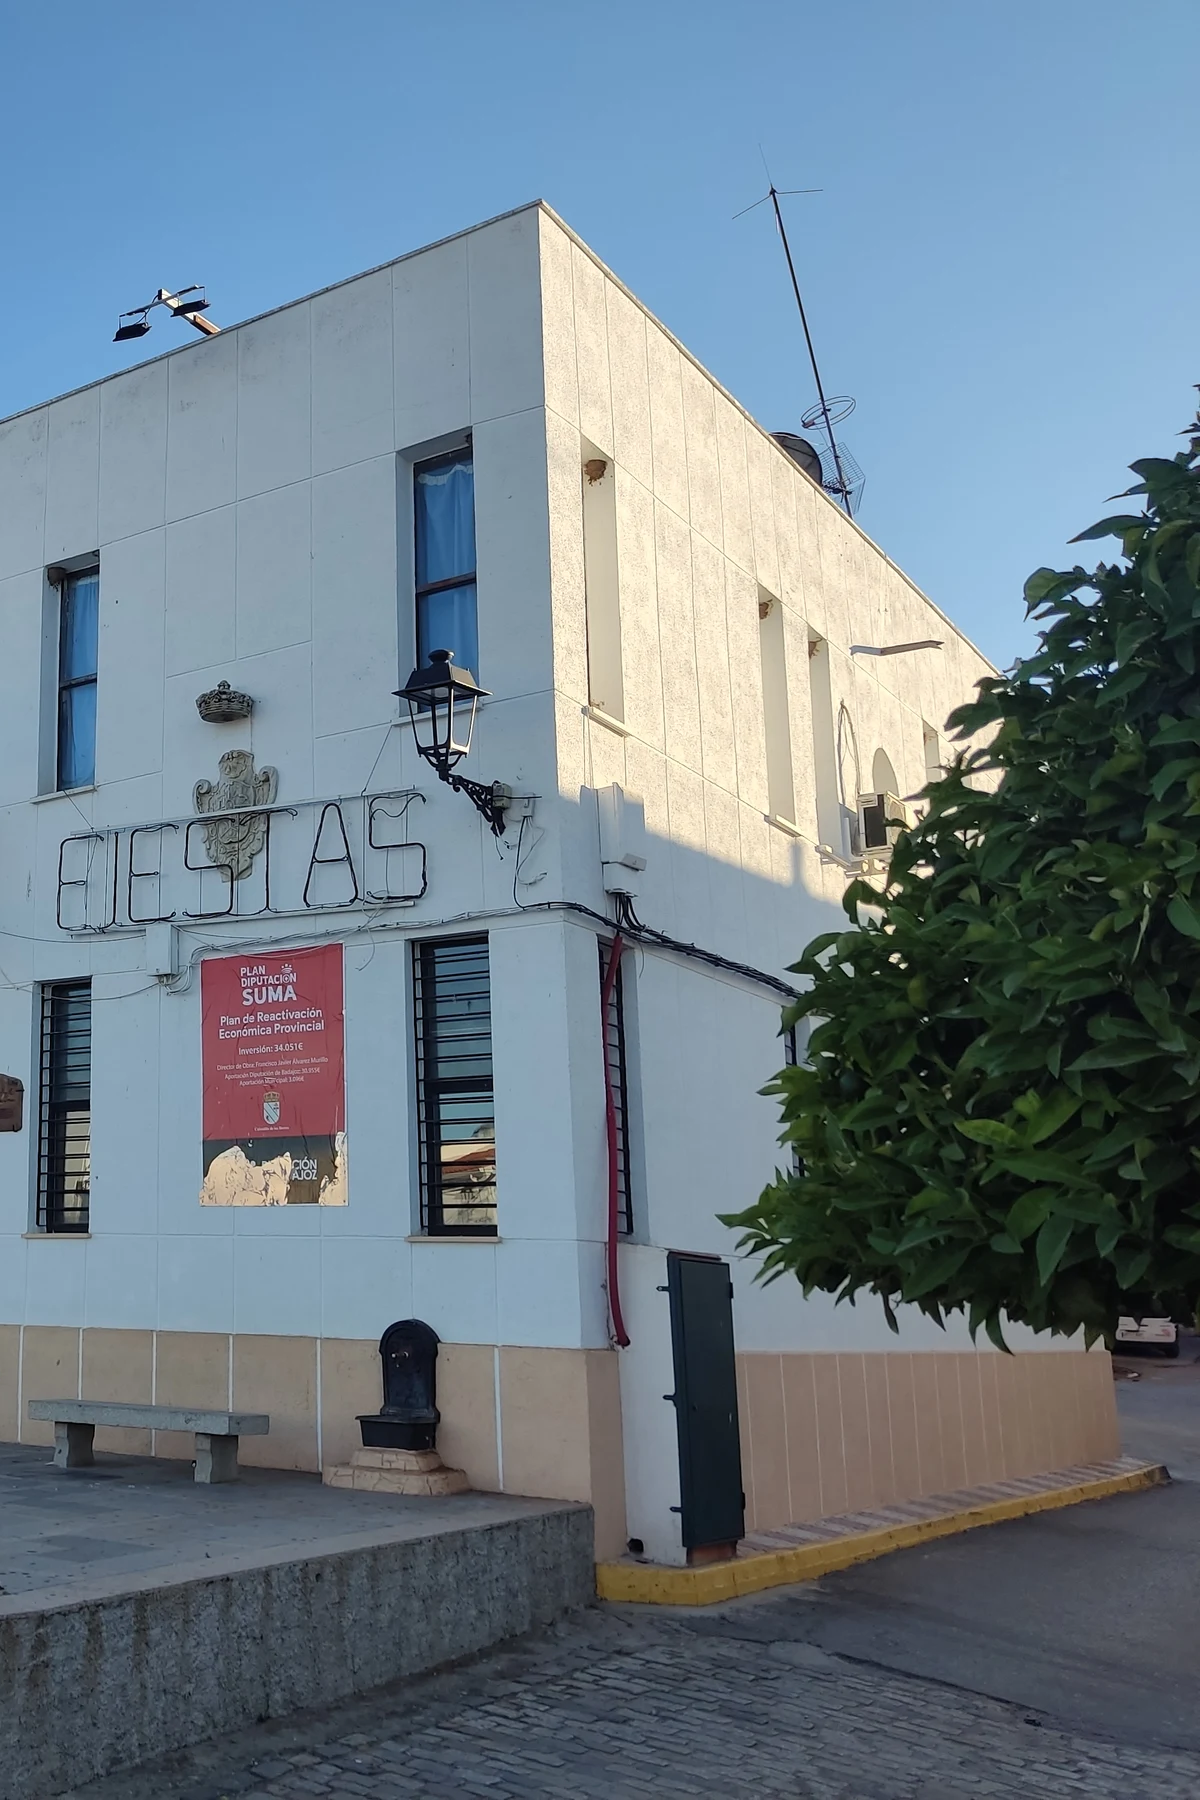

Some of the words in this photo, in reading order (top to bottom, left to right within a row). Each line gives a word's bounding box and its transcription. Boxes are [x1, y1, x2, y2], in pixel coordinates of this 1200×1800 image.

[241, 965, 265, 976] PLAN
[242, 984, 297, 1006] SUMA
[220, 1016, 240, 1026] Plan
[243, 1013, 255, 1023] de
[257, 1007, 322, 1022] Reactivación
[219, 1026, 272, 1039] Económica
[274, 1020, 324, 1034] Provincial
[238, 1045, 273, 1055] Inversión:
[274, 1043, 303, 1052] 34.051€
